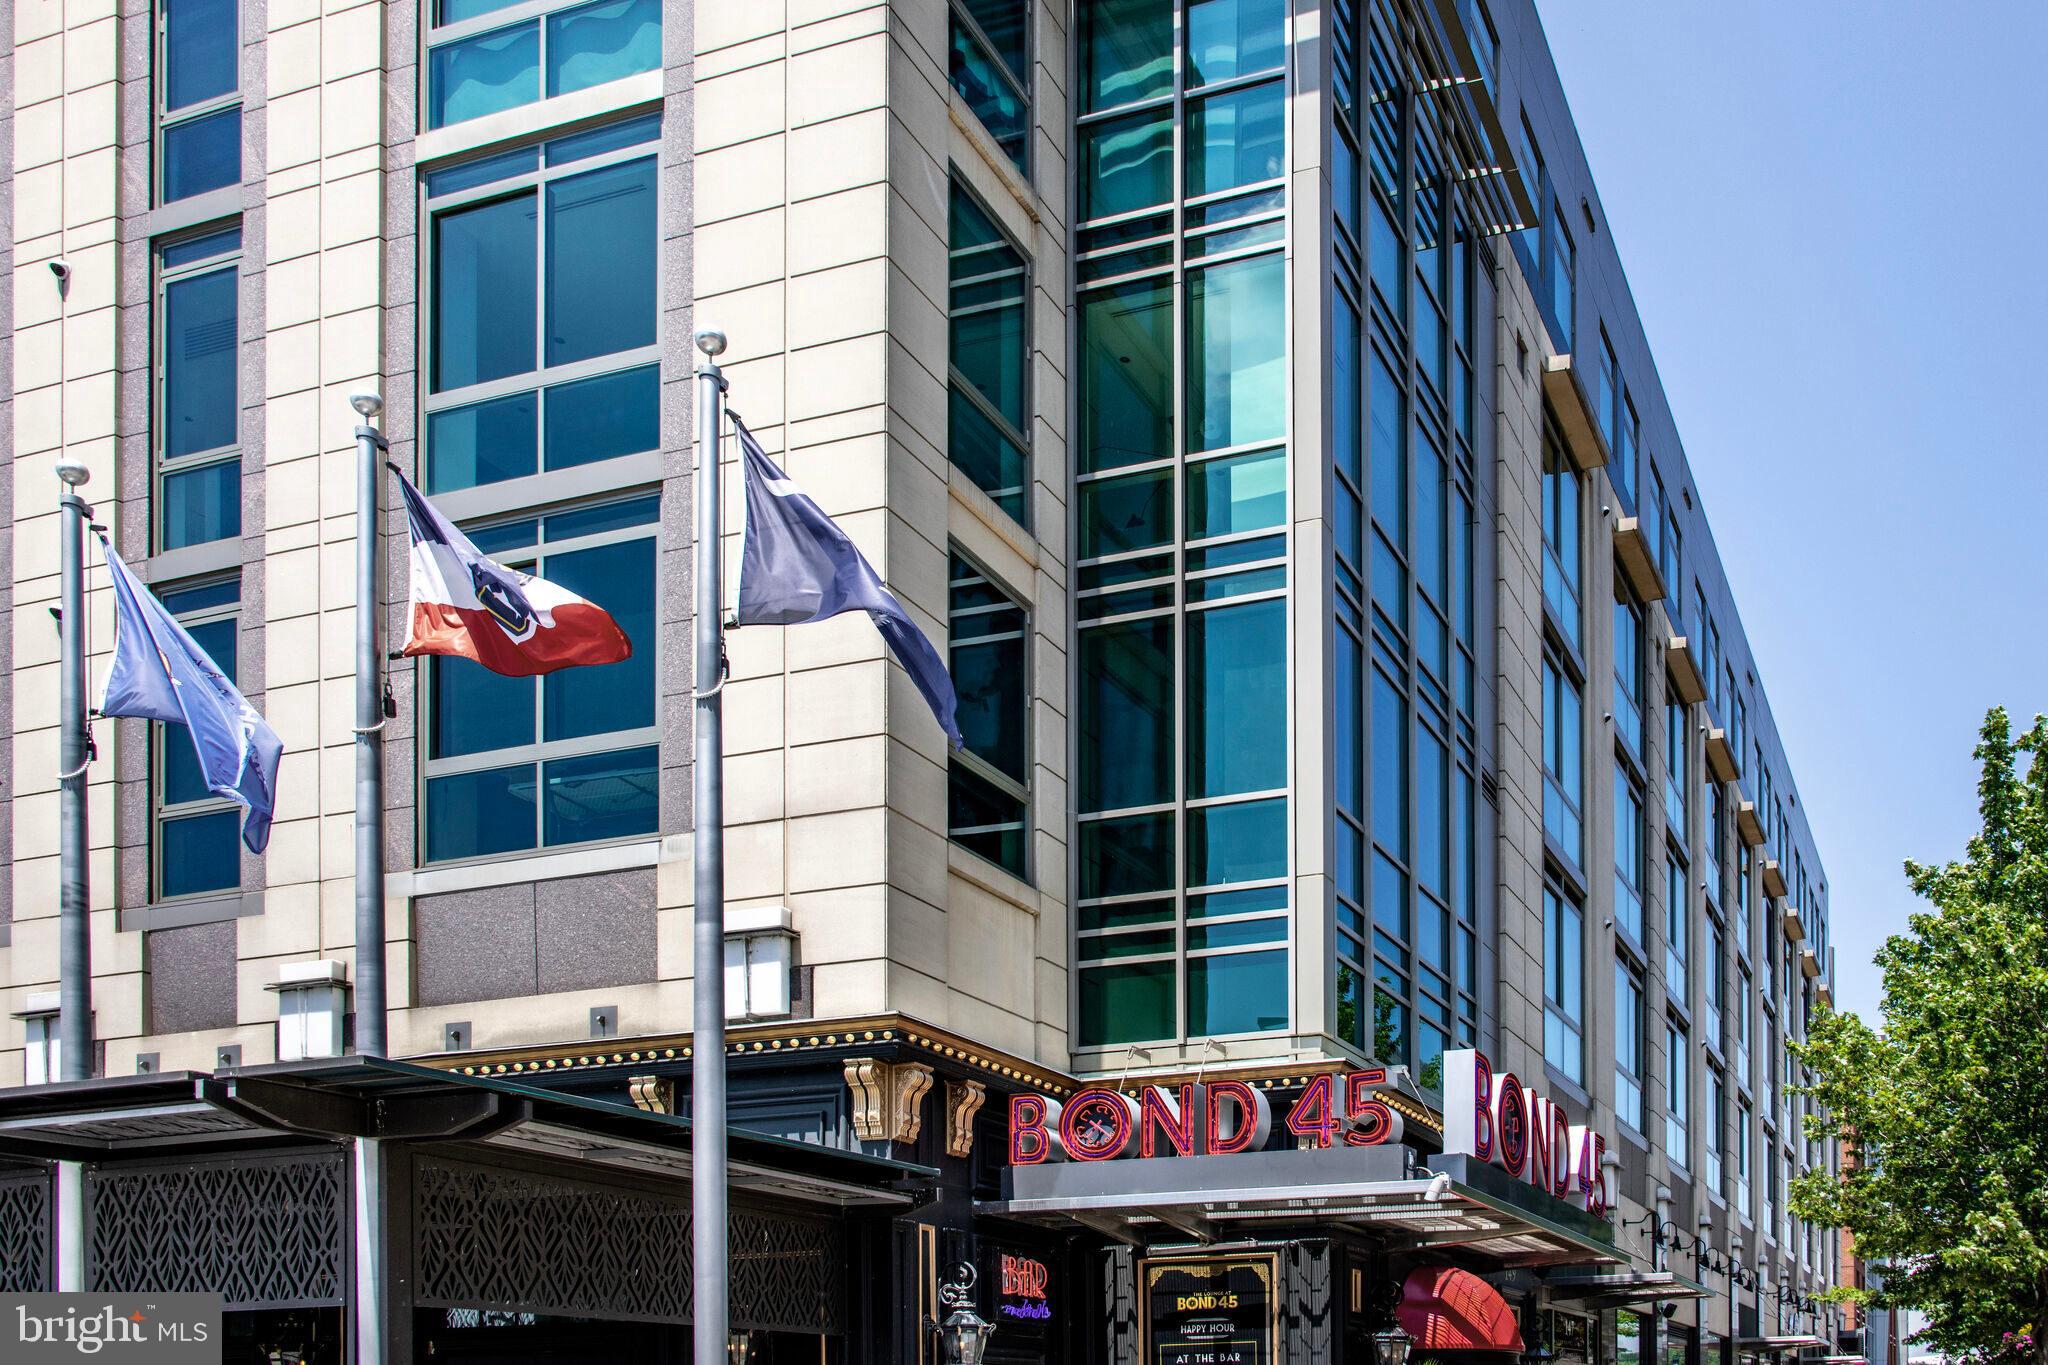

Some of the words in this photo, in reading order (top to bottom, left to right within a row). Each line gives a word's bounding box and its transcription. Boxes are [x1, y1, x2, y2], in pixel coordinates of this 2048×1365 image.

[1008, 1078, 1260, 1167] BOND
[1284, 1067, 1394, 1150] 45
[1475, 1049, 1570, 1201] BOND
[1578, 1127, 1607, 1220] 45
[1002, 1255, 1048, 1299] BAR
[1177, 1296, 1217, 1310] BOND
[1218, 1295, 1239, 1309] 45
[1180, 1324, 1207, 1334] HAPPY
[1209, 1323, 1235, 1333] HOUR
[1176, 1354, 1190, 1364] AT
[1194, 1353, 1215, 1363] THE
[1219, 1352, 1241, 1362] BAR
